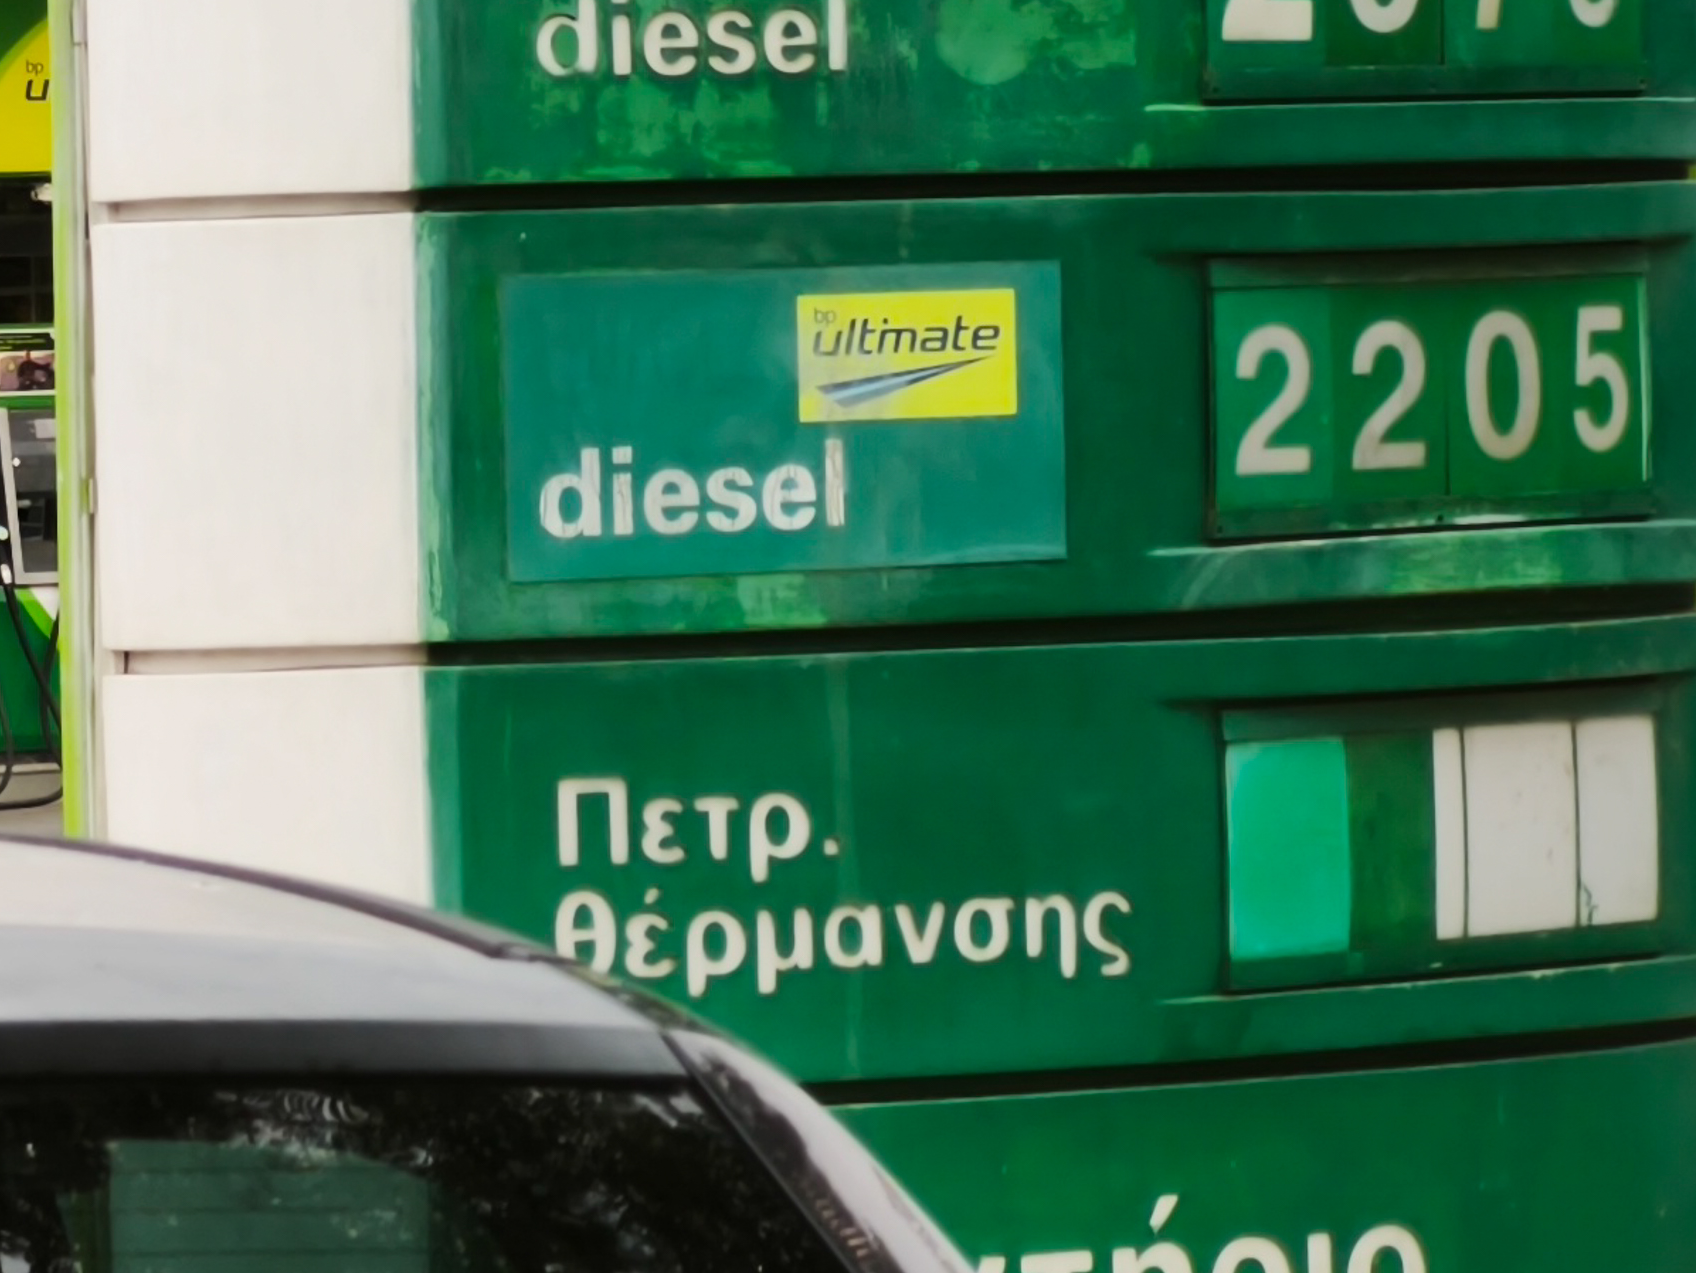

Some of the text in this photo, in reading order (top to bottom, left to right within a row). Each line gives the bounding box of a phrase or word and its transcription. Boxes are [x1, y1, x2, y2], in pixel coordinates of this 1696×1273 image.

[25, 60, 44, 76] bp
[812, 315, 1001, 356] ultimate
[814, 307, 837, 326] bp
[1233, 305, 1631, 477] 2205
[538, 439, 847, 539] diesel
[555, 776, 841, 881] Πετρ.
[555, 888, 1133, 996] θέρμανσης
